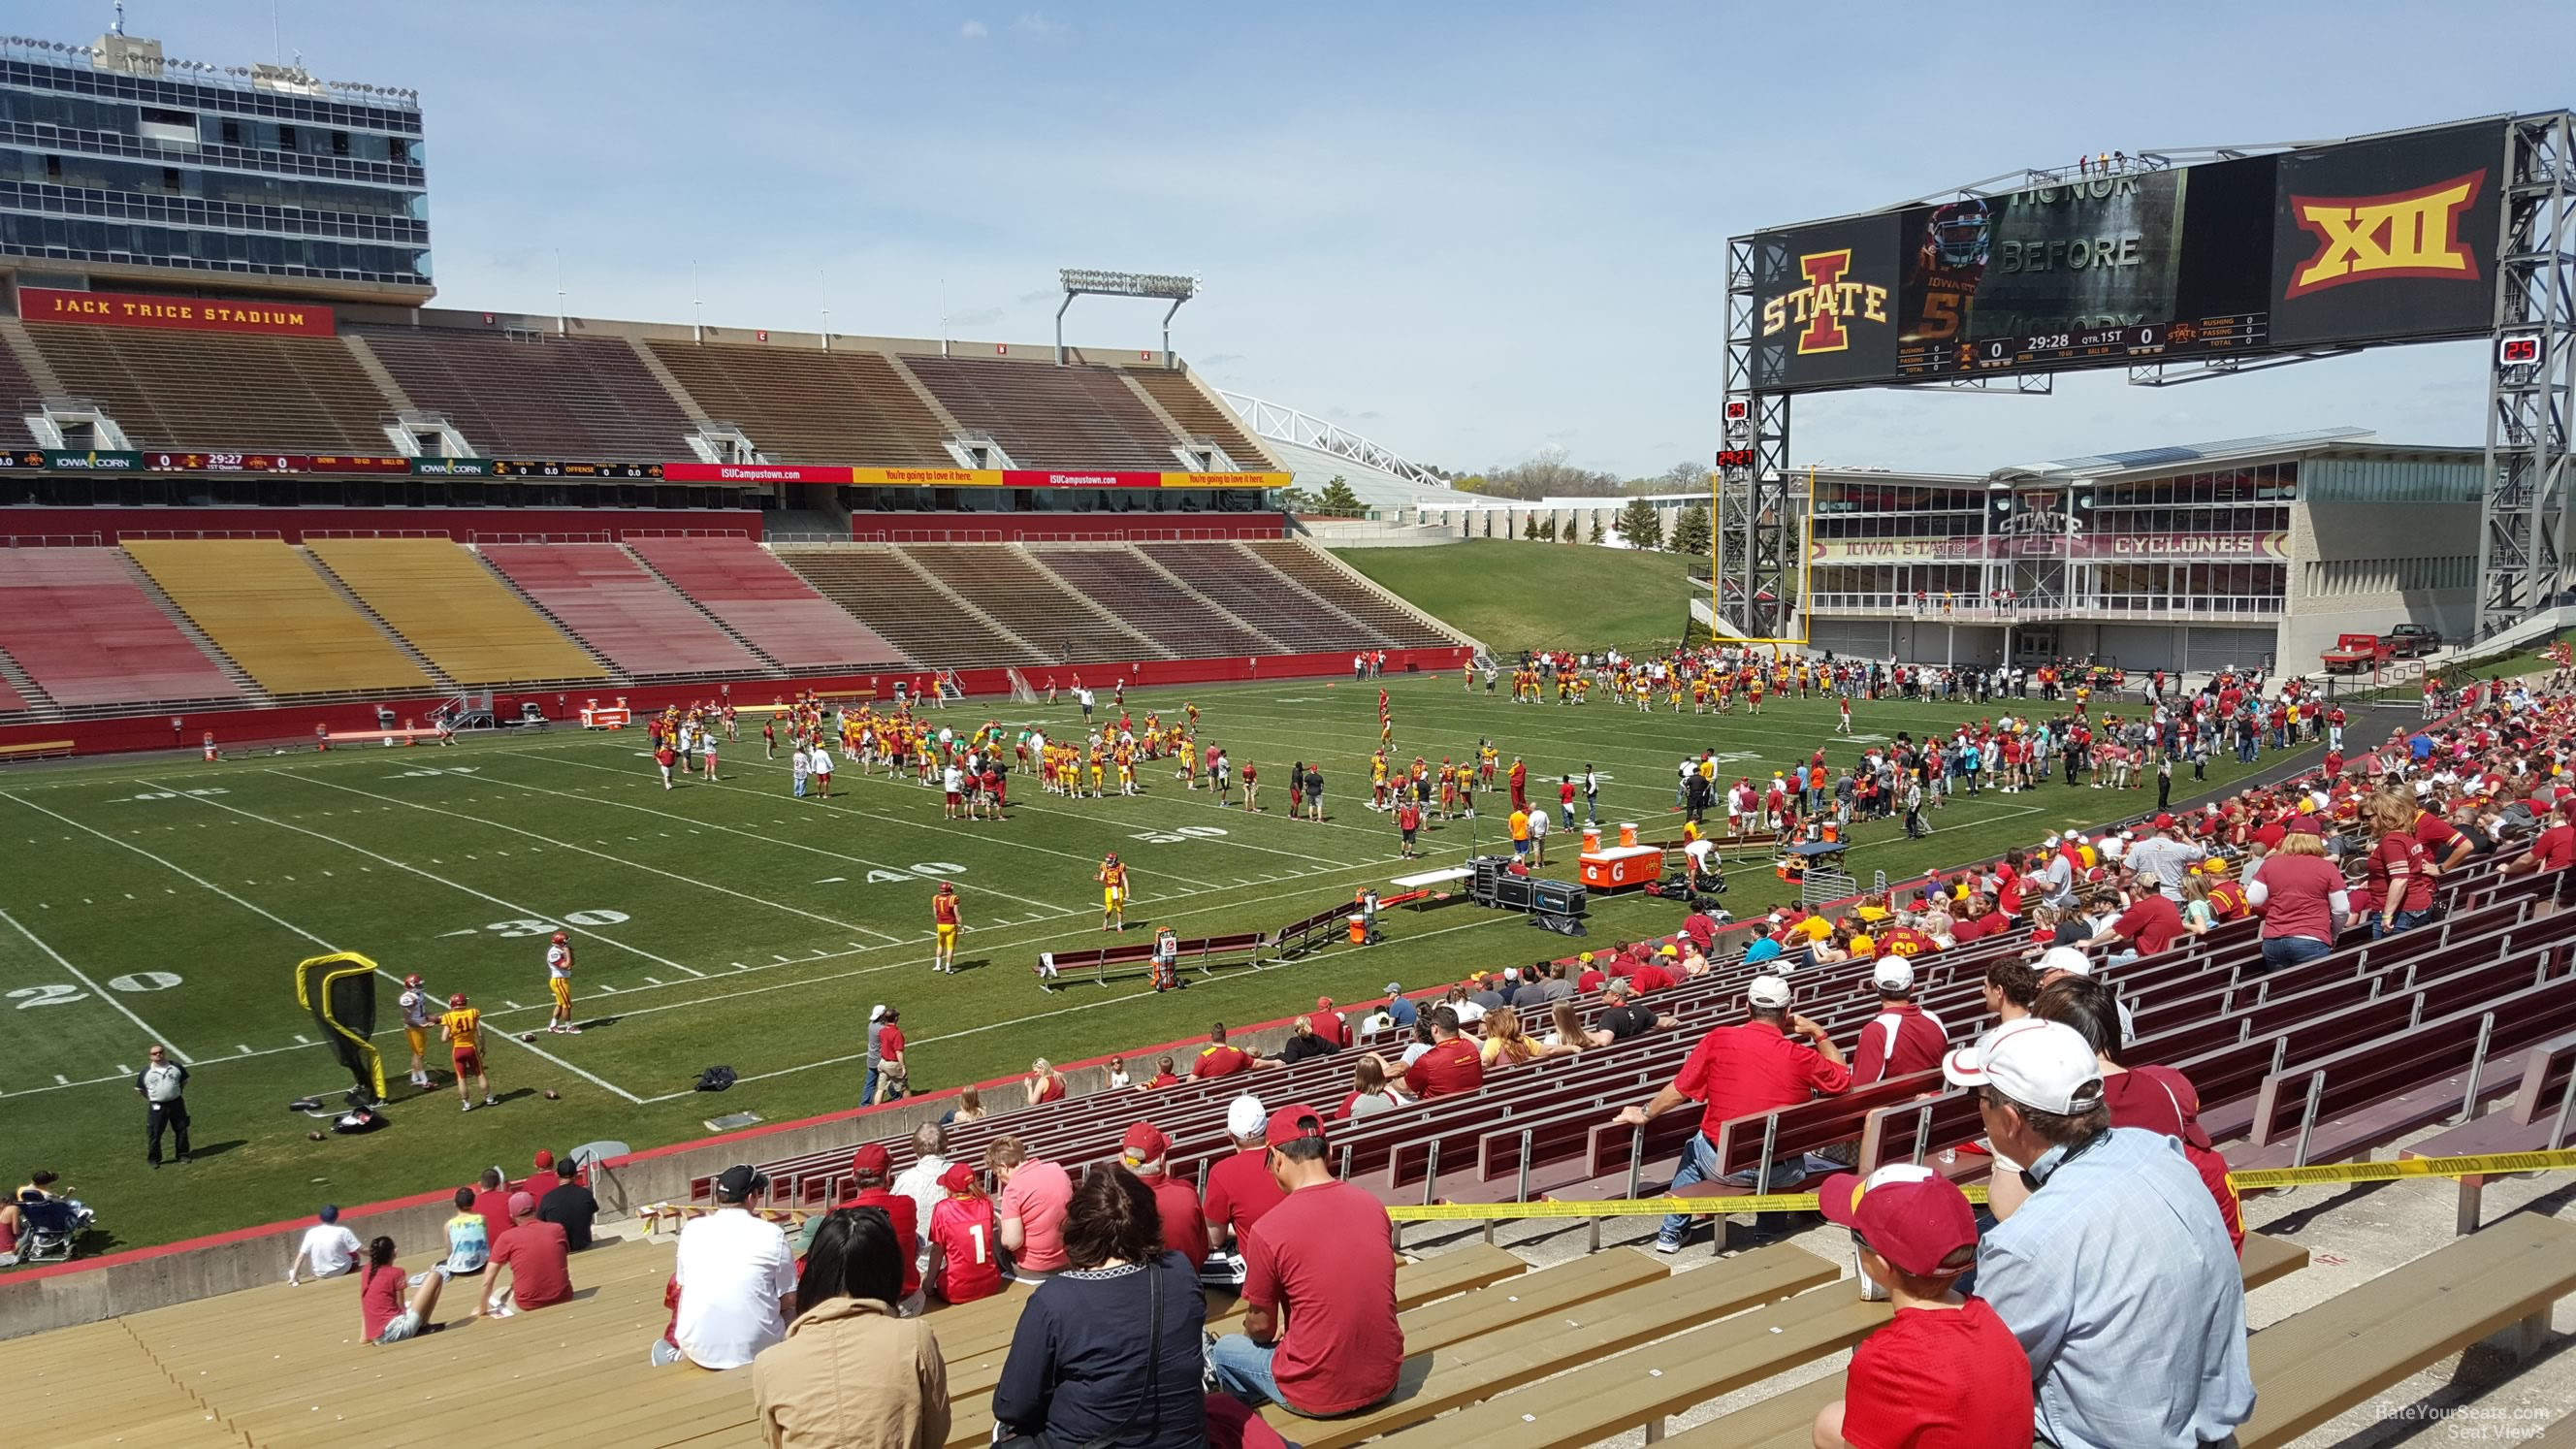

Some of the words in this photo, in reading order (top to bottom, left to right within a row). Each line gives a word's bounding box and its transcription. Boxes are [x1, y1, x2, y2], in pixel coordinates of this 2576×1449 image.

[2298, 181, 2471, 288] XII
[1999, 234, 2141, 274] BEFORE
[1927, 276, 1960, 290] IOWA
[54, 298, 111, 315] JACK
[123, 303, 193, 319] TRICE
[204, 308, 306, 326] STADIUM
[1762, 282, 1888, 338] STATE
[2203, 317, 2235, 327] RUSHING
[2081, 335, 2100, 345] QTR.
[2100, 330, 2123, 342] 1ST
[2141, 328, 2153, 344] 0
[2167, 329, 2197, 340] STATE
[2203, 328, 2233, 337] PASSING
[2246, 326, 2252, 335] 0
[2027, 334, 2070, 350] 29:28
[1991, 342, 2003, 358] 0
[2506, 340, 2533, 360] 25
[1899, 356, 1924, 365] PASSING
[1728, 403, 1745, 418] 25
[56, 458, 88, 467] IOWA
[96, 459, 130, 467] CORN
[160, 455, 171, 467] 0
[209, 454, 242, 465] 29:27
[277, 457, 288, 468] 0
[1718, 450, 1753, 466] 29:27
[420, 465, 446, 473] IOWA
[453, 466, 482, 474] CORN
[520, 467, 528, 475] 0
[565, 466, 596, 474] OFFENSE
[603, 468, 610, 477] 0
[628, 468, 641, 477] 0.0
[721, 467, 801, 481] ISUCampustown.com
[886, 469, 906, 480] You're
[907, 471, 925, 483] going
[926, 471, 933, 481] to
[934, 471, 949, 481] love
[950, 472, 954, 481] it
[1049, 474, 1116, 485] ISUCampustown.com
[1189, 474, 1206, 484] You're
[1207, 475, 1223, 485] going
[1223, 475, 1231, 484] to
[1231, 475, 1243, 484] love
[1999, 510, 2083, 541] STATE
[1846, 540, 1895, 557] IOWA
[1902, 539, 1966, 557] STATE
[2114, 535, 2254, 554] CYCLONES
[1126, 825, 1230, 844] 50
[866, 862, 968, 884] 40
[1587, 865, 1598, 880] G
[1612, 861, 1625, 882] G
[486, 909, 630, 938] 30
[5, 971, 183, 1010] 20
[455, 1016, 471, 1034] 41
[969, 1224, 986, 1265] 1
